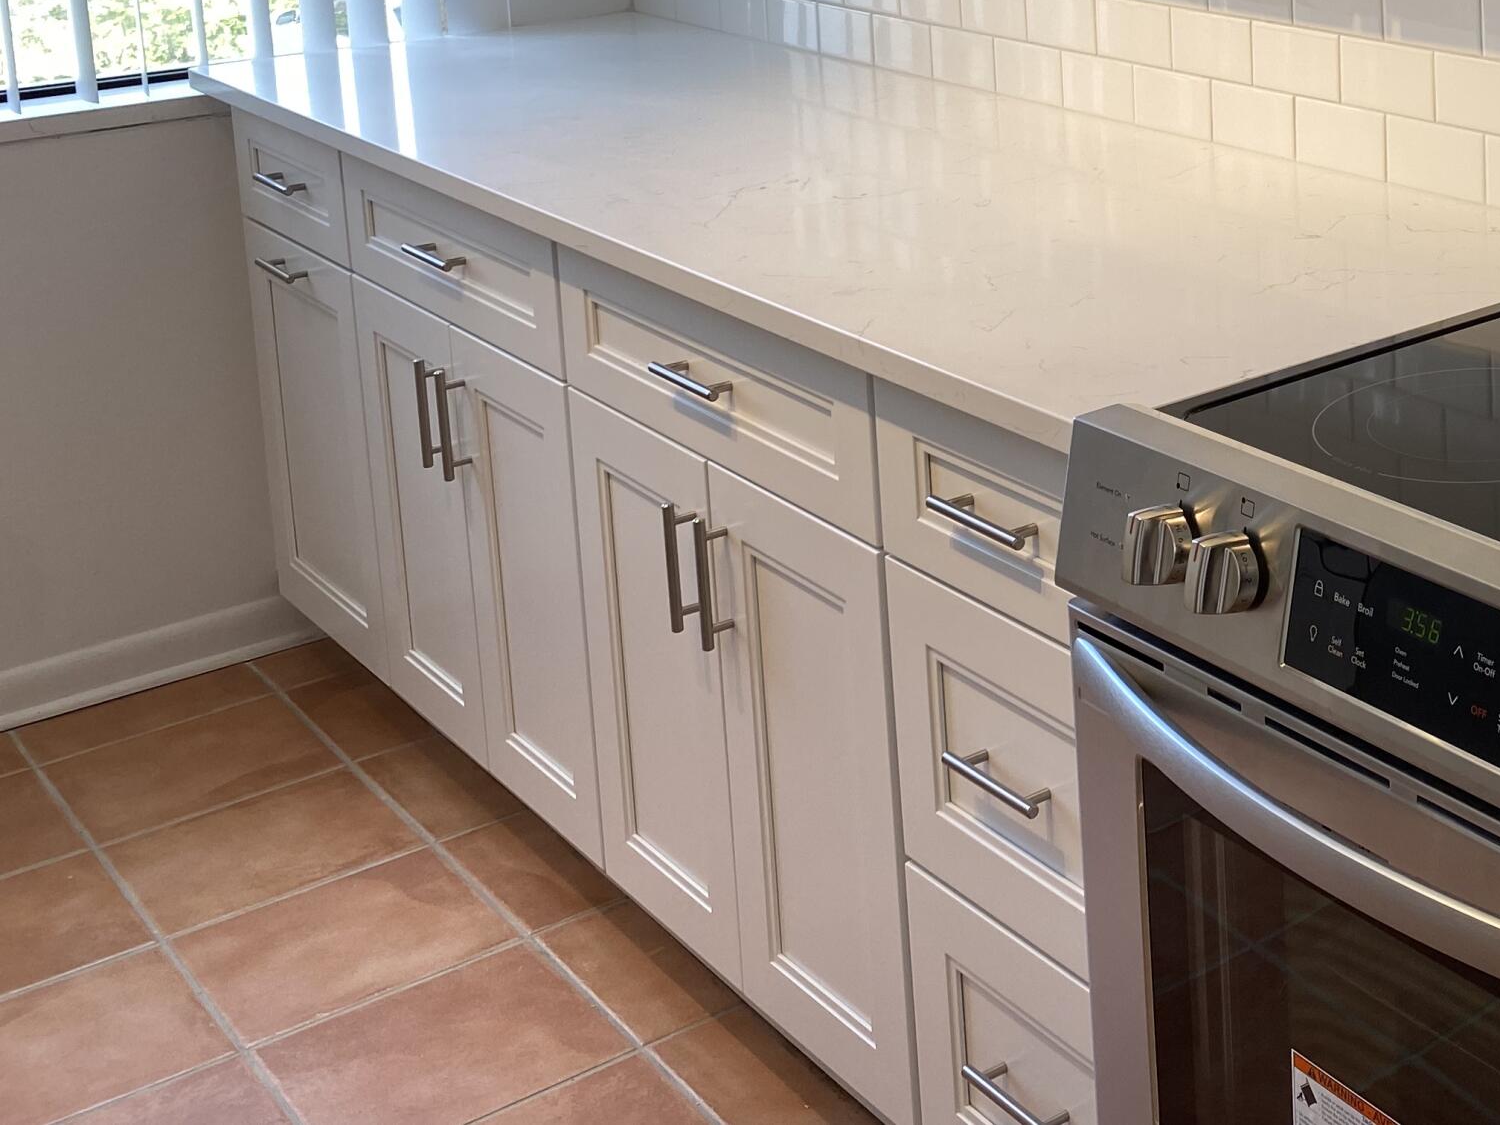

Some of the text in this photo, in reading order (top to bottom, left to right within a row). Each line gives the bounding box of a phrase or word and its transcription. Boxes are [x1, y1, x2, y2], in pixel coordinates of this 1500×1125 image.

[1334, 592, 1350, 607] Bake
[1357, 602, 1374, 617] Broil
[1400, 607, 1443, 645] 3:56
[1331, 635, 1342, 647] Self
[1327, 644, 1343, 658] Clean
[1355, 647, 1365, 658] Set
[1351, 656, 1367, 669] Clock
[1477, 652, 1495, 667] Timer
[1473, 662, 1496, 678] On-Off
[1471, 705, 1488, 719] OFF
[1318, 1072, 1365, 1112] WARNING
